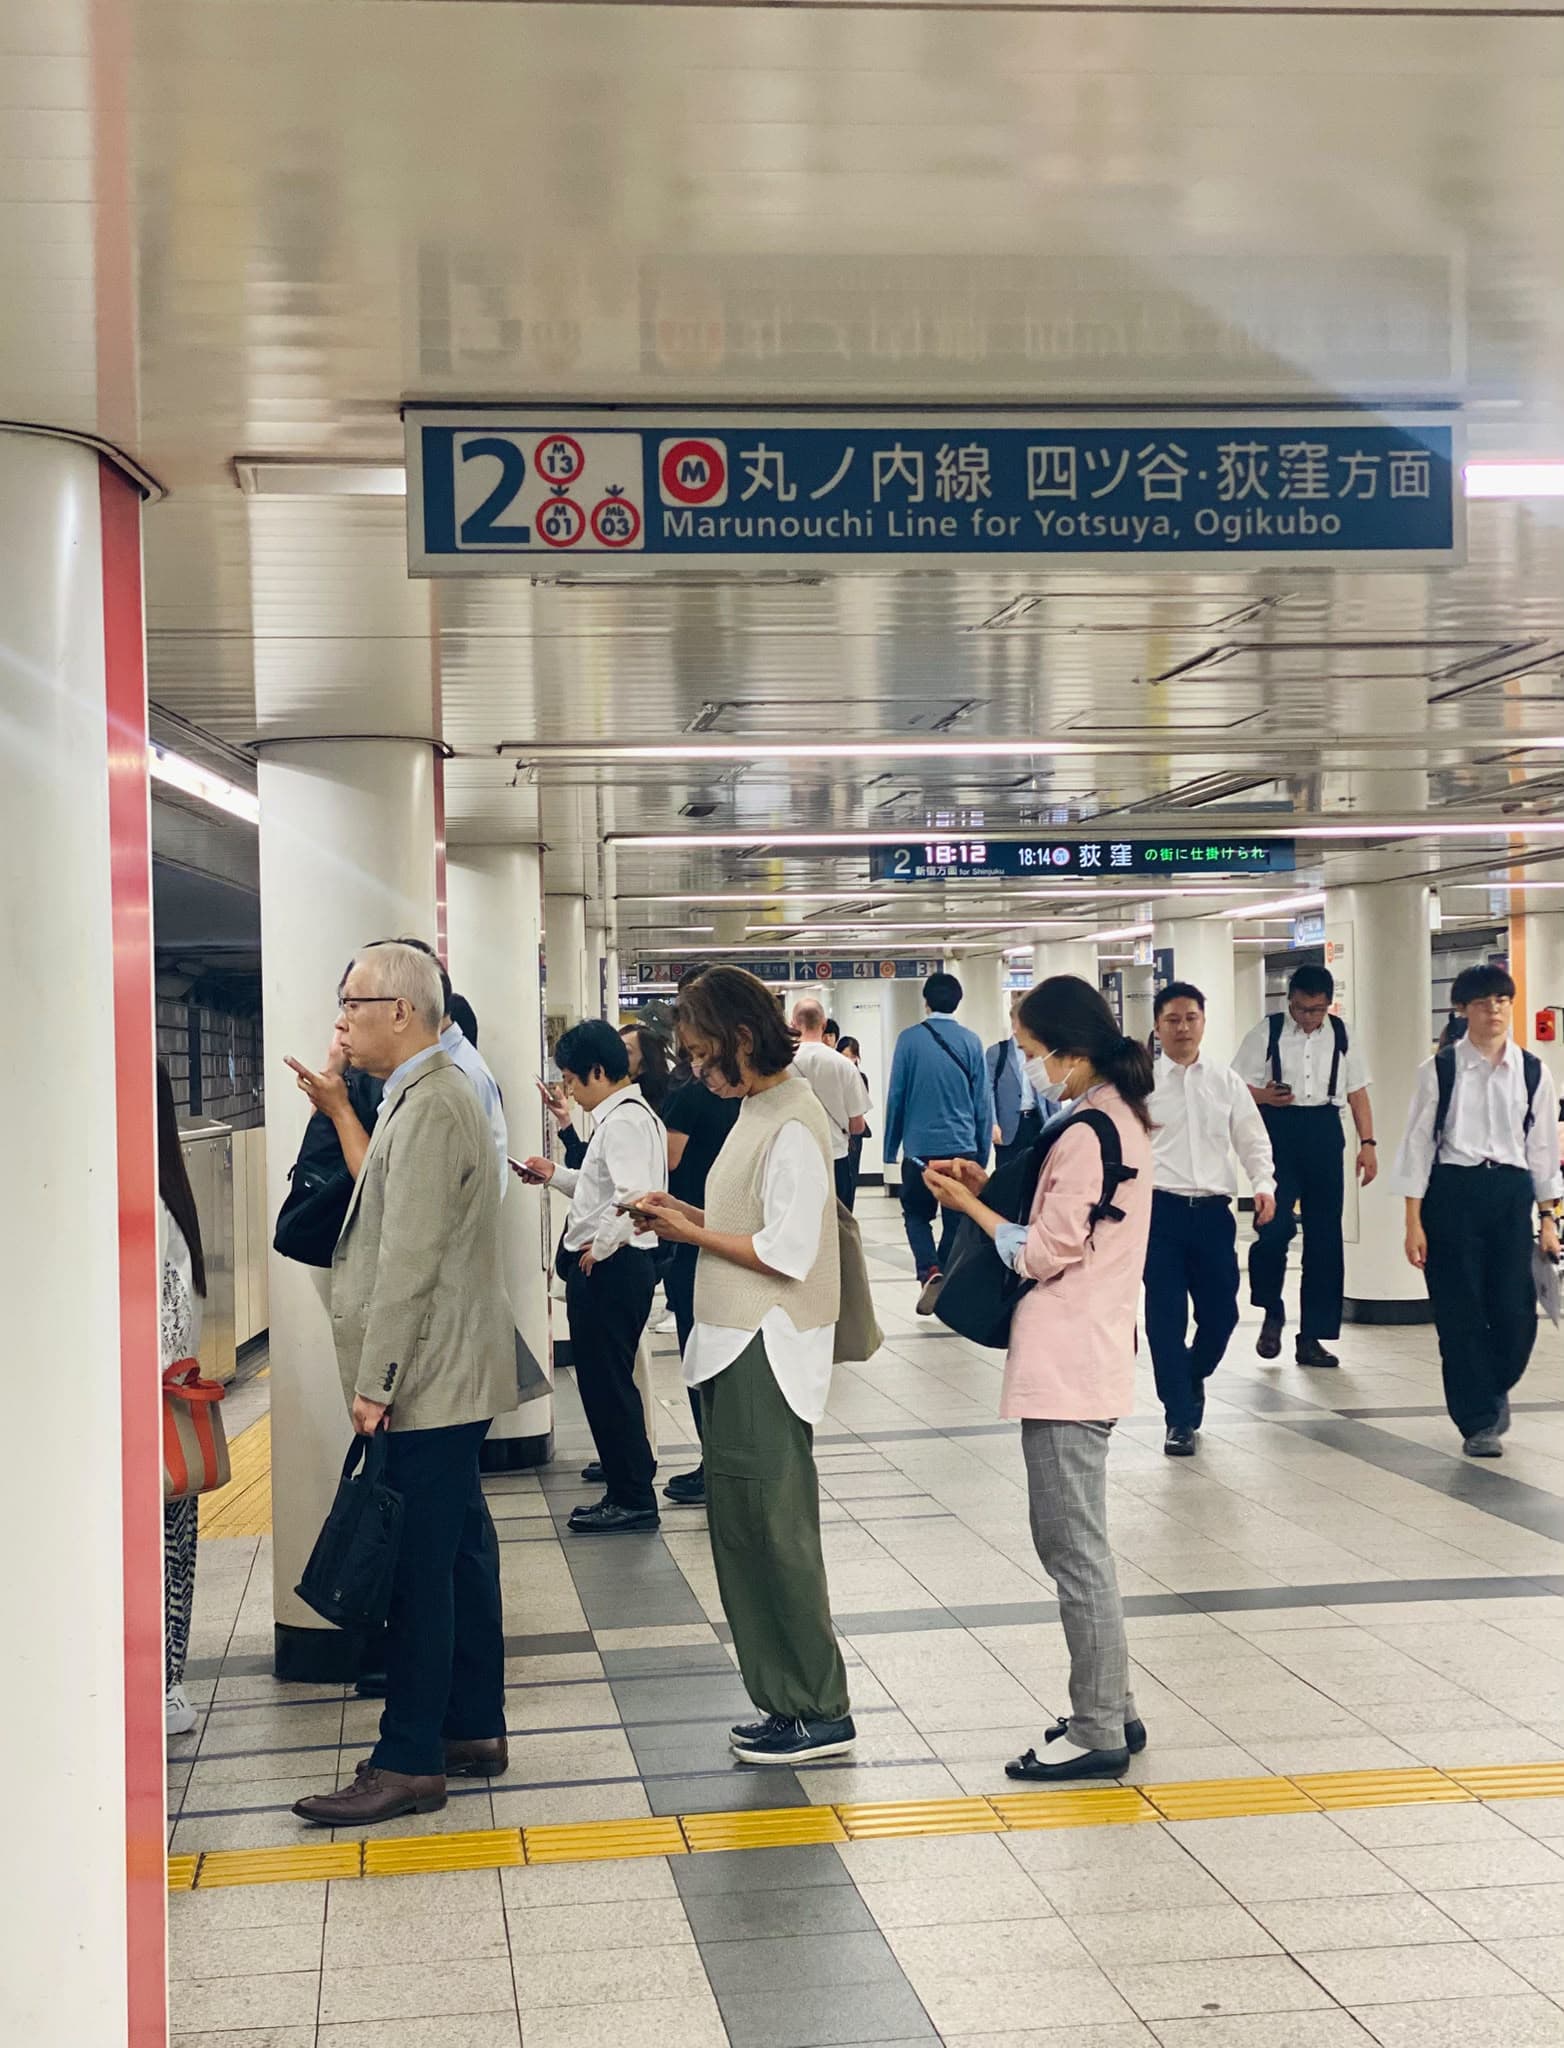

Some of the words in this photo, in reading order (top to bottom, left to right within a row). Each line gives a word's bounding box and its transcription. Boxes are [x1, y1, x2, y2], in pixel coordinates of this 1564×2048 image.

[552, 444, 566, 453] M
[547, 456, 573, 473] 13
[681, 461, 706, 482] M
[740, 443, 992, 502] 丸ノ内線
[461, 438, 530, 543] 2
[554, 506, 567, 516] M
[546, 518, 571, 535] 01
[601, 518, 629, 535] 03
[663, 509, 873, 538] Marunouchi
[888, 509, 958, 537] Line
[970, 508, 1021, 537] for
[1034, 509, 1180, 544] Yotsuya,
[1194, 507, 1341, 543] Ogikubo
[893, 849, 911, 874] 2
[925, 845, 986, 863] 18:12
[1018, 848, 1051, 866] 18:14
[1079, 844, 1132, 867] 荻窪
[1144, 846, 1265, 862] の街に仕掛けられ
[644, 966, 653, 981] 2
[855, 964, 865, 977] 4
[919, 963, 928, 975] 3
